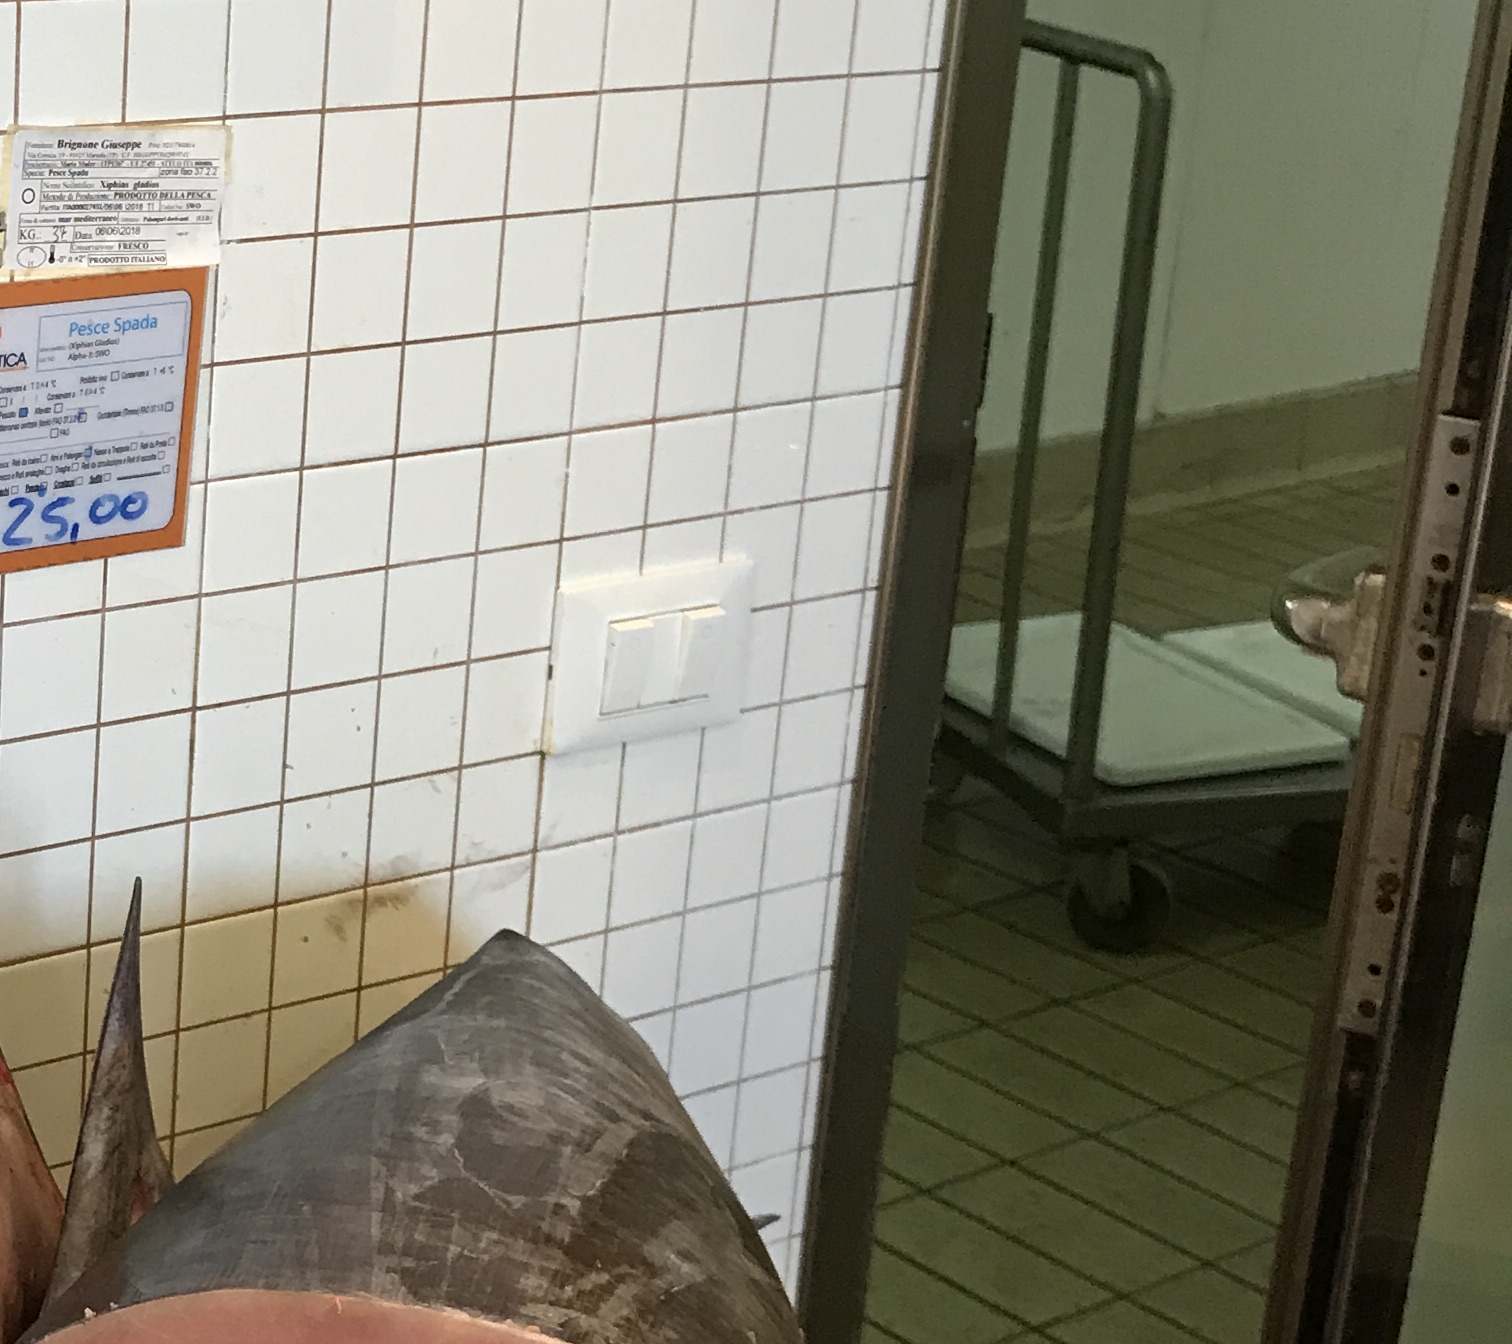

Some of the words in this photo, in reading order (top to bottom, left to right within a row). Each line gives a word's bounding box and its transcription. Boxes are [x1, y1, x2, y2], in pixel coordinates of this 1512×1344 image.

[57, 139, 99, 151] Brignone
[101, 140, 142, 151] Giuseppe
[48, 169, 66, 177] Pesce
[68, 169, 89, 179] Spada
[133, 181, 159, 192] gladius
[114, 191, 158, 199] PRODOTTO
[187, 191, 211, 199] PESCA
[73, 215, 118, 223] mediterraneo
[118, 242, 150, 251] FRESCO
[89, 255, 130, 264] PRODOTTO
[131, 254, 166, 263] ITALIANO
[69, 321, 110, 337] Pesce
[113, 314, 158, 335] Spada
[2, 490, 149, 546] 25,00
